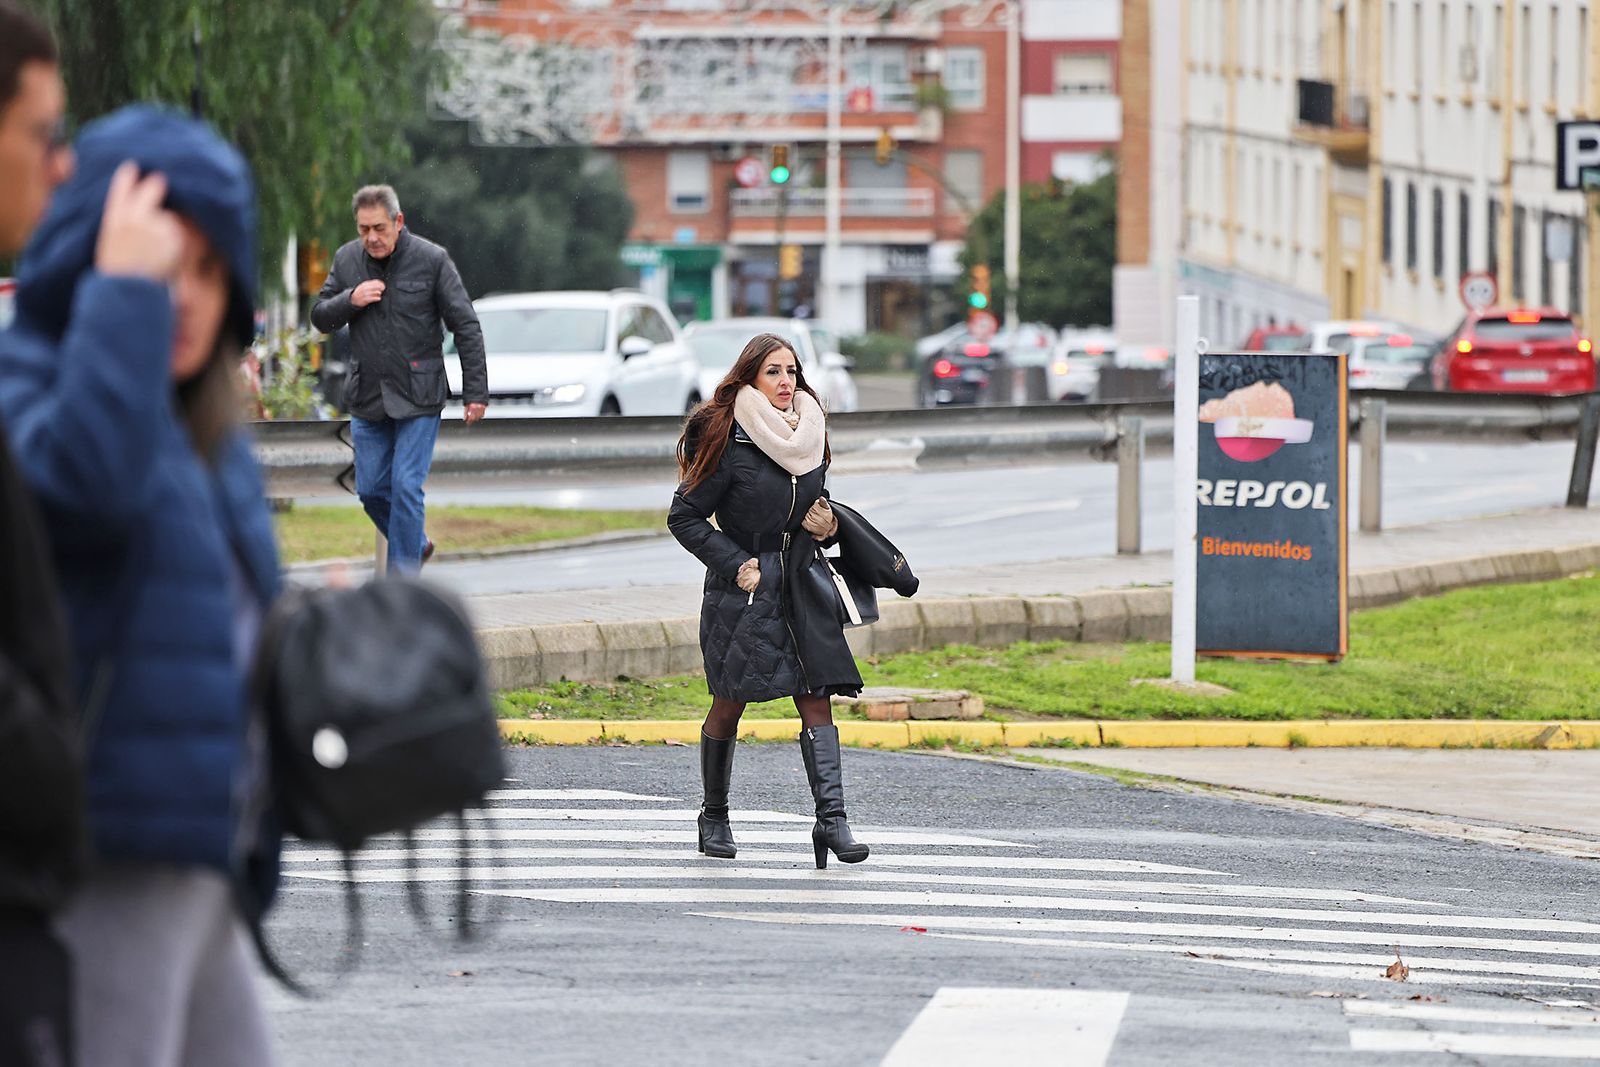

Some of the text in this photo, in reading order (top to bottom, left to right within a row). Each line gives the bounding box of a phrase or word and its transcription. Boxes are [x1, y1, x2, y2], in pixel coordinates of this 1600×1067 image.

[1565, 125, 1600, 187] P
[1197, 479, 1331, 509] REPSOL
[1202, 537, 1312, 560] Bienvenidos
